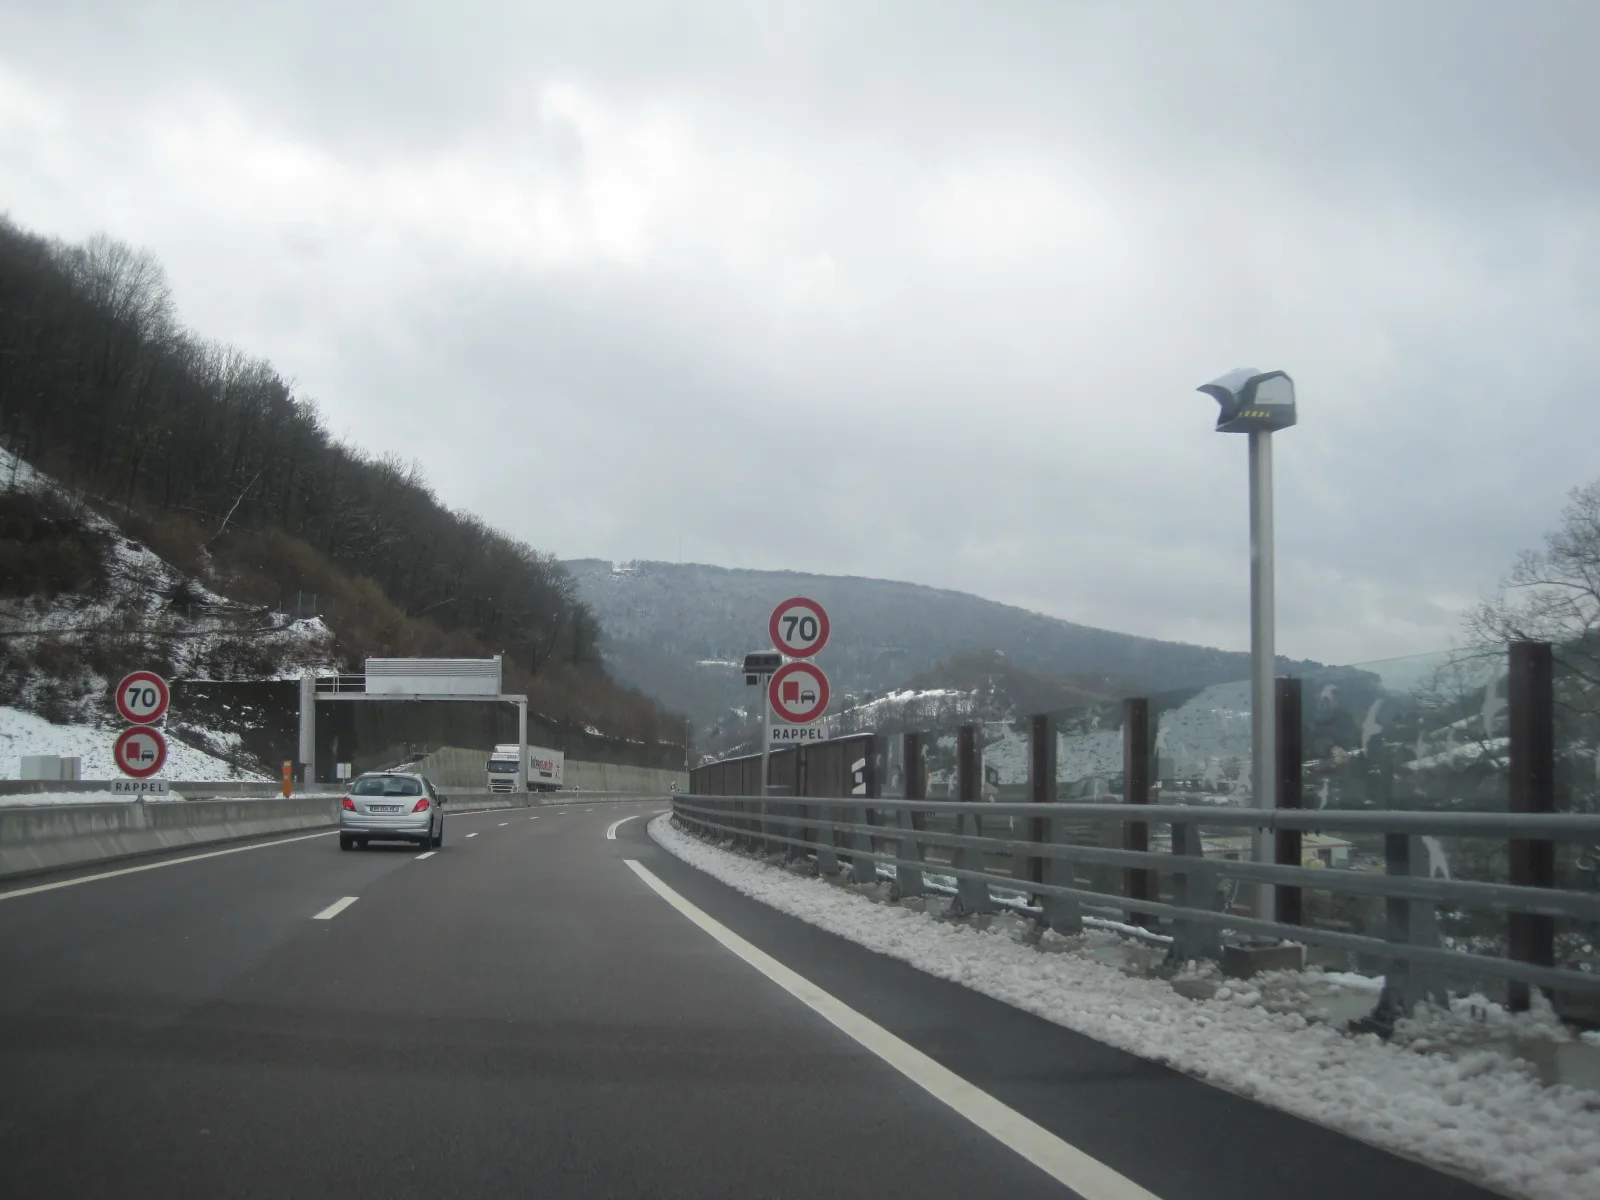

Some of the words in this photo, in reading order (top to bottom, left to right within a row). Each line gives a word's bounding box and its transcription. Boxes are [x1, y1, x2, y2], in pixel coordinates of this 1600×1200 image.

[782, 616, 818, 642] 70
[128, 687, 157, 708] 70
[773, 728, 824, 740] RAPPEL
[115, 782, 165, 792] RAPPEL
